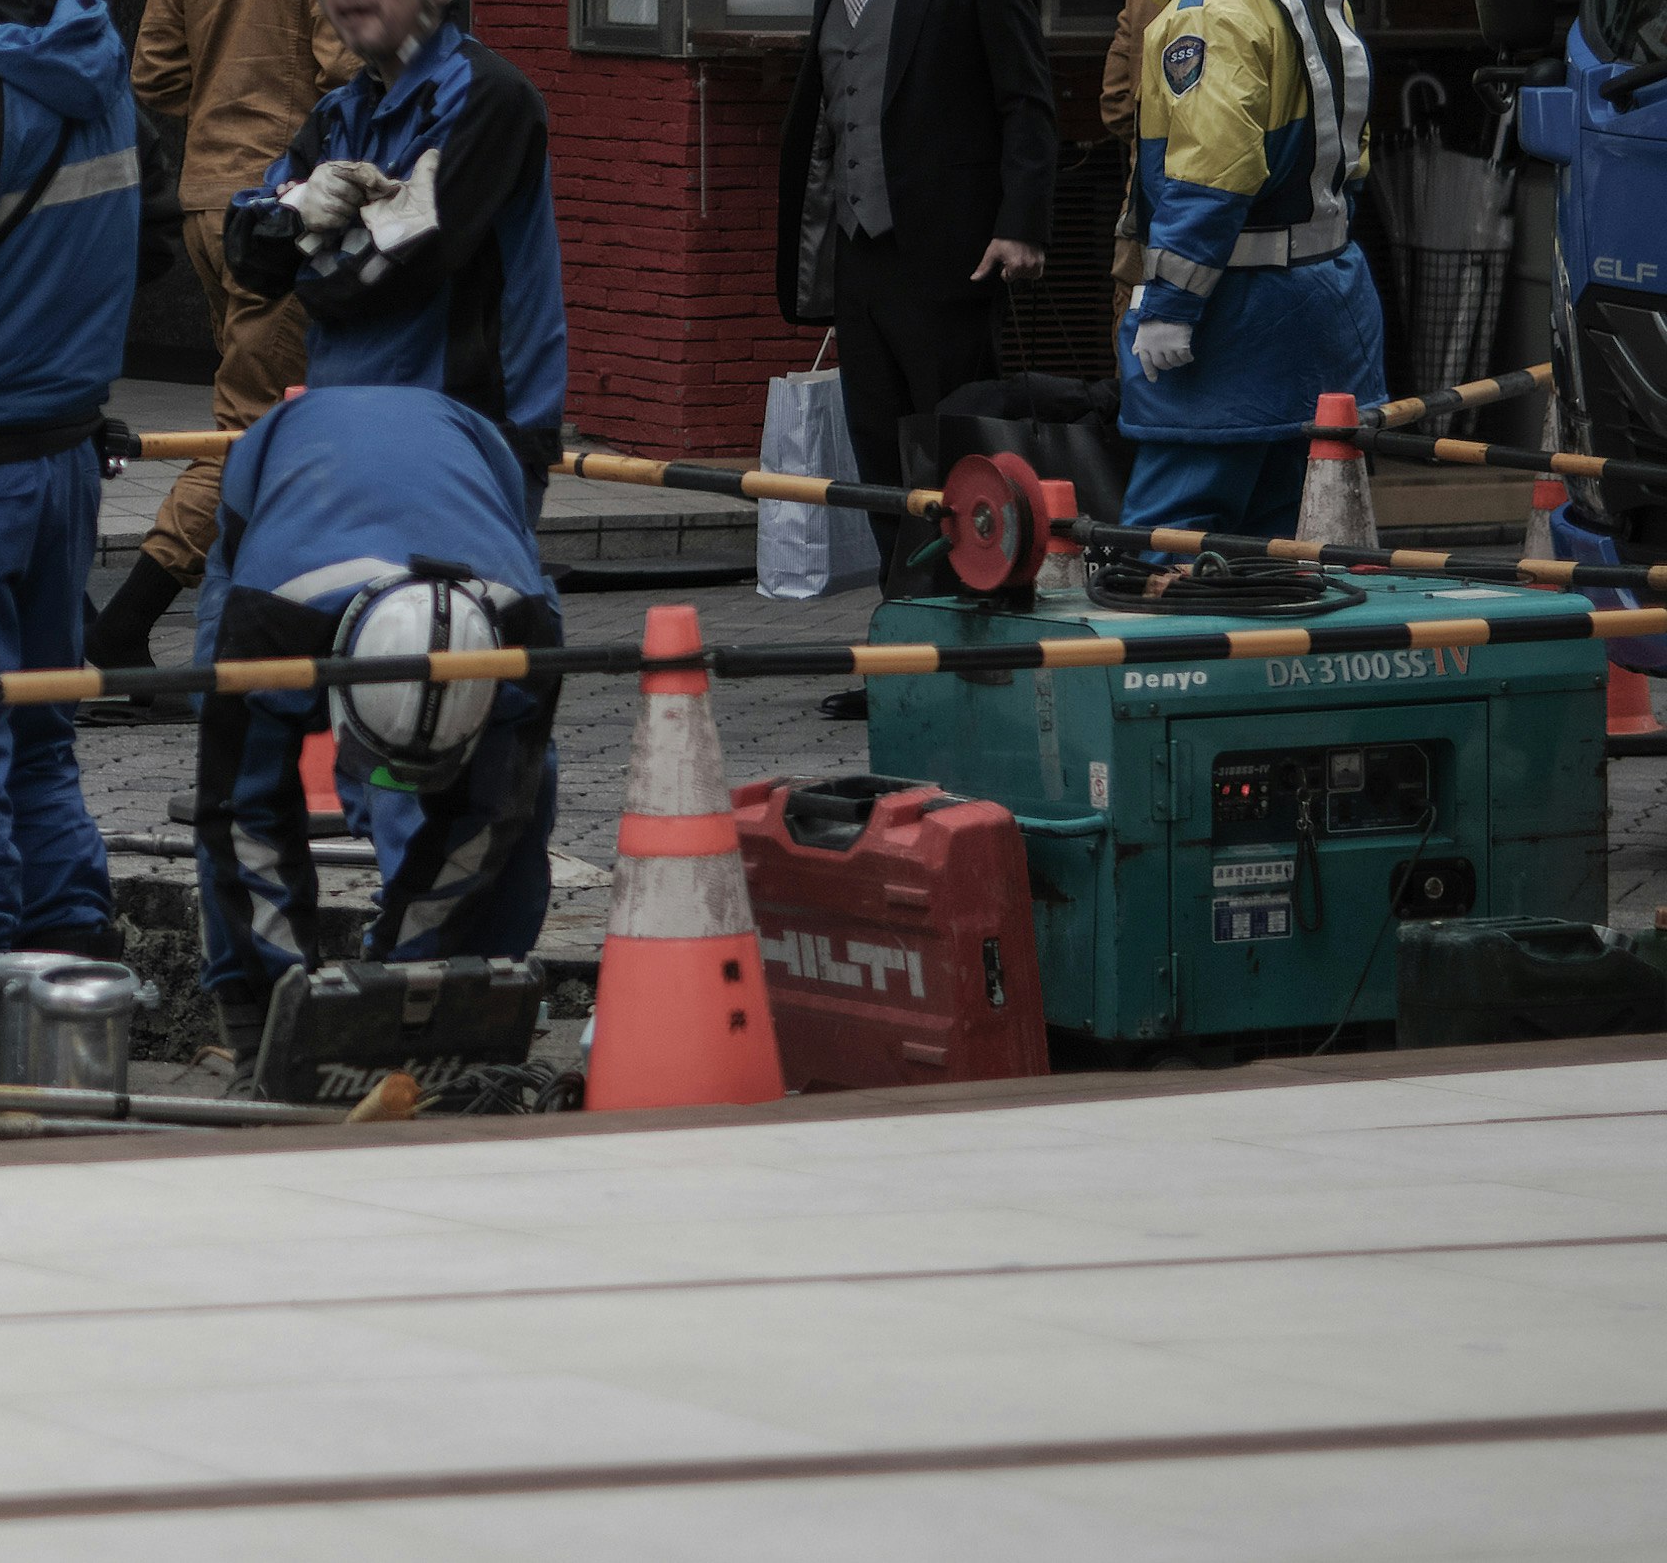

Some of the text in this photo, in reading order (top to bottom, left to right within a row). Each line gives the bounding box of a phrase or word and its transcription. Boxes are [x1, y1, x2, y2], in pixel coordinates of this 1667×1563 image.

[1169, 46, 1195, 63] SSS
[1593, 255, 1659, 284] ELF
[1123, 670, 1209, 691] Denyo
